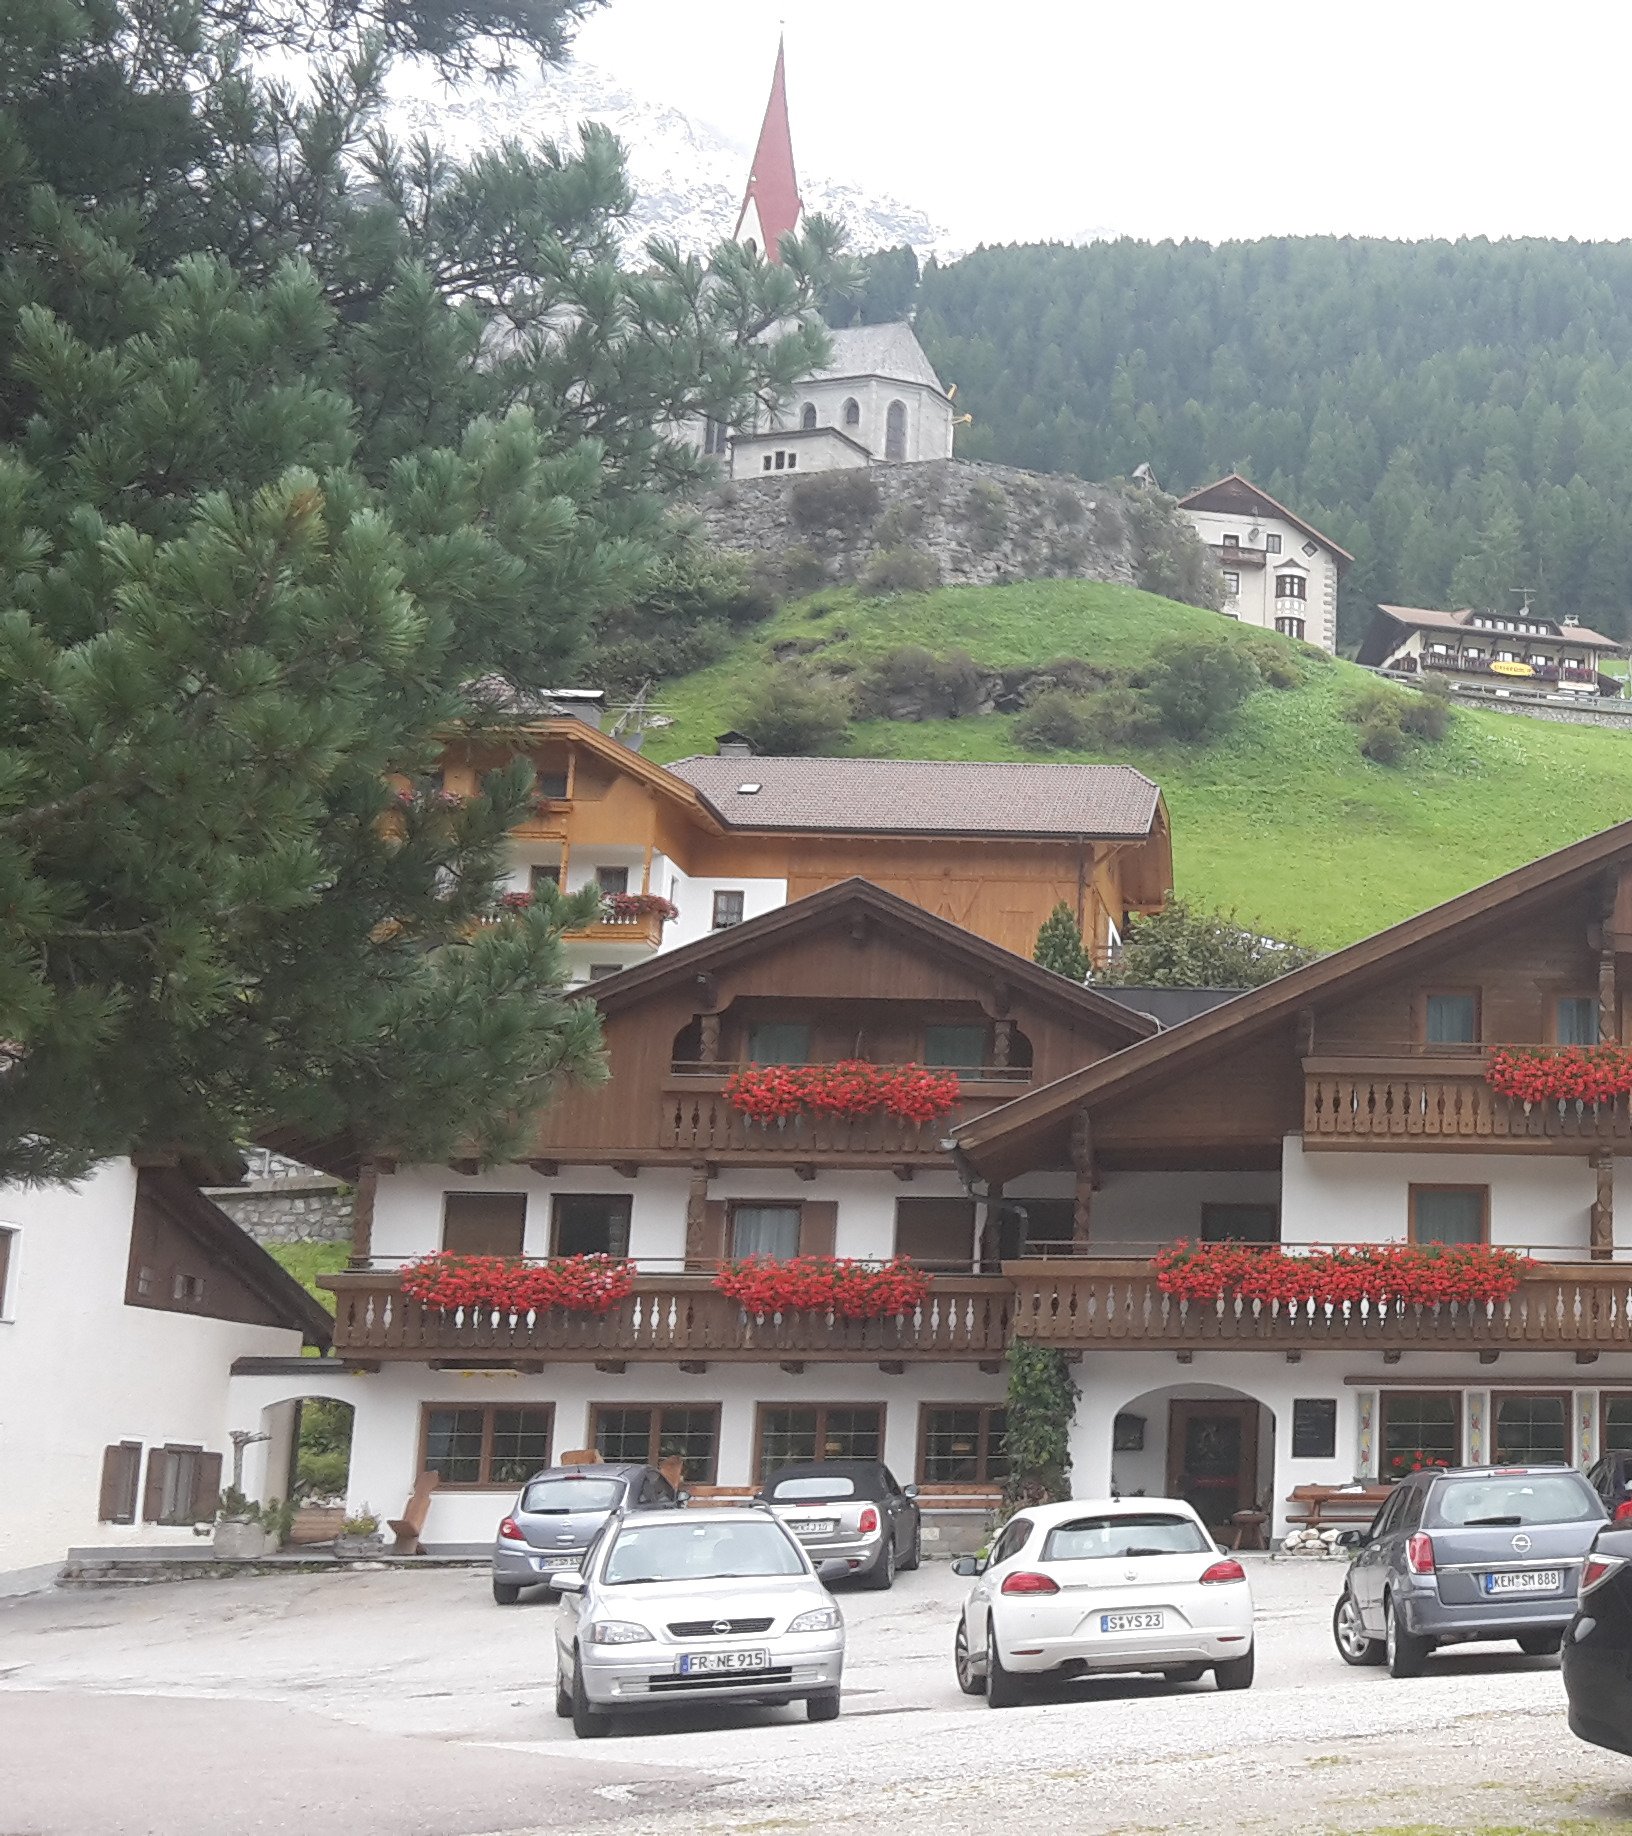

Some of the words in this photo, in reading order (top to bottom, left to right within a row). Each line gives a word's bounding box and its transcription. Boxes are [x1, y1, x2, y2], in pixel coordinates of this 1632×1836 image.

[1125, 1615, 1143, 1628] YS
[1144, 1613, 1161, 1627] 23
[689, 1655, 708, 1670] FR
[716, 1654, 735, 1668] NE
[737, 1652, 763, 1667] 915
